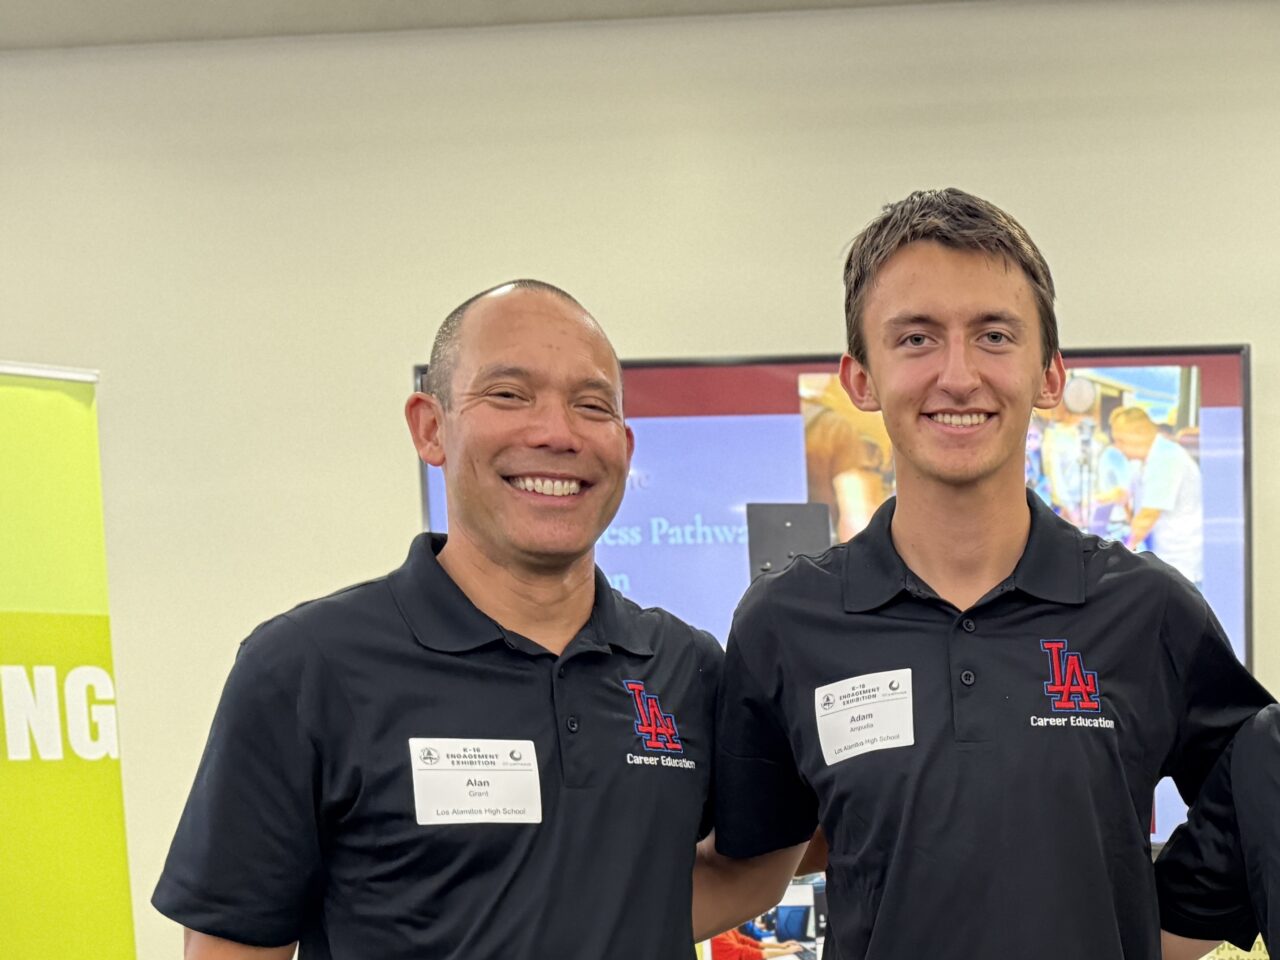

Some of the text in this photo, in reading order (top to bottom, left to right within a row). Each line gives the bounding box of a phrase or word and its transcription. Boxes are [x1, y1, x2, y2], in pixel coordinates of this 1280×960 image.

[1040, 639, 1101, 713] LA
[0, 665, 120, 761] NG
[622, 679, 684, 754] LA
[850, 712, 873, 724] Adam
[1030, 715, 1115, 729] Career Education
[864, 737, 878, 745] High
[879, 734, 900, 742] School
[626, 753, 696, 769] Career Education
[466, 779, 490, 787] Alan
[468, 790, 489, 798] Grant
[484, 807, 501, 816] High
[502, 807, 526, 815] School
